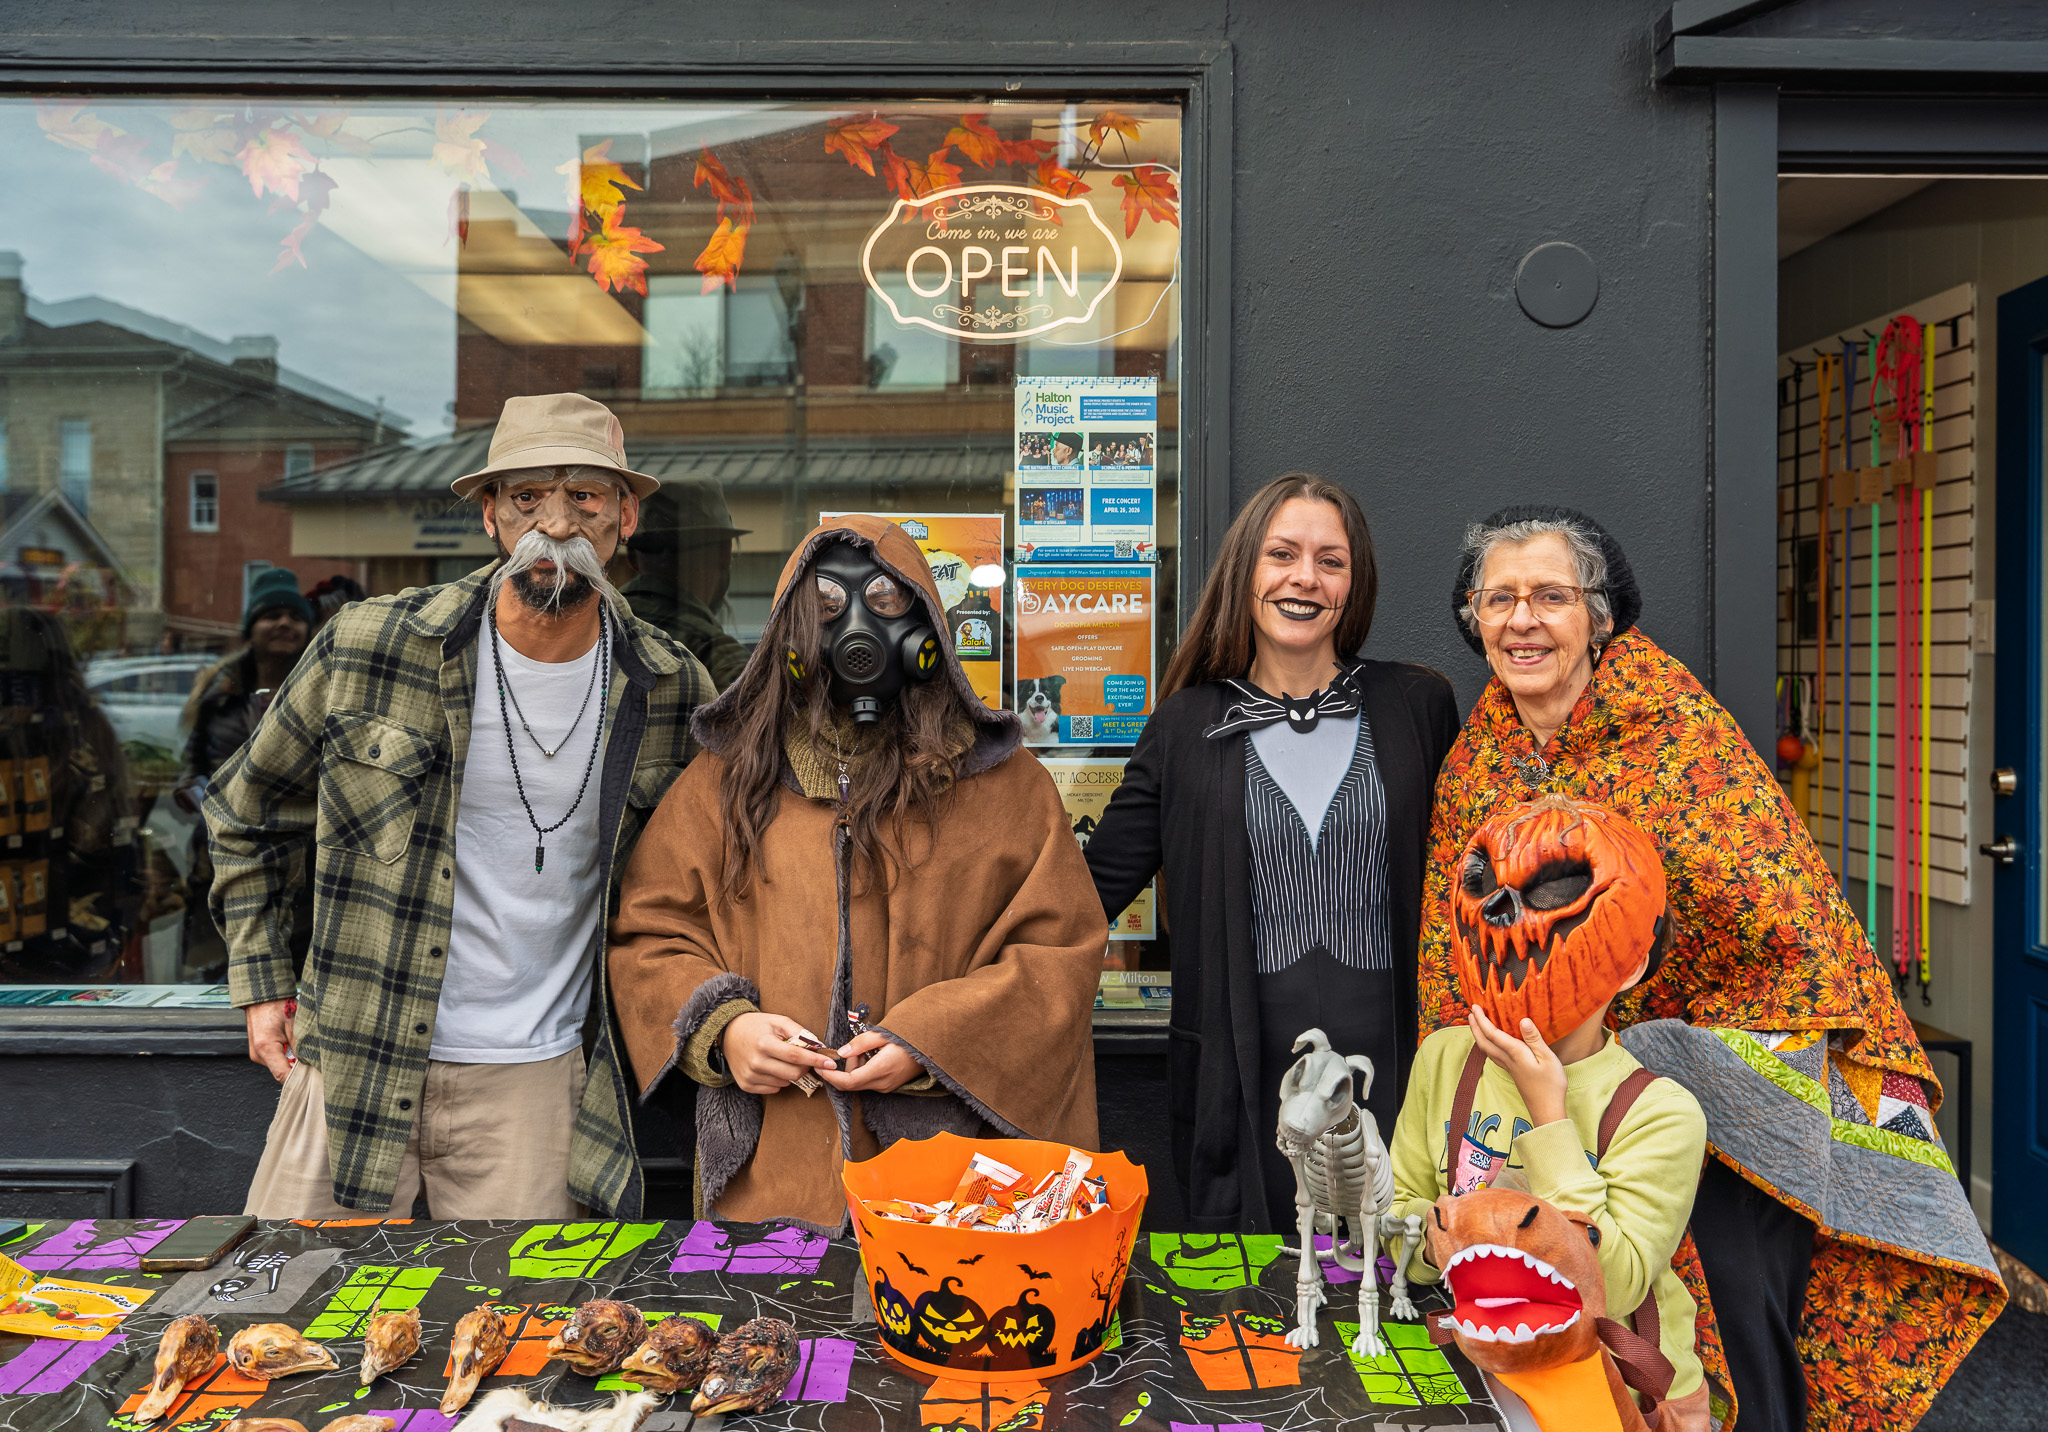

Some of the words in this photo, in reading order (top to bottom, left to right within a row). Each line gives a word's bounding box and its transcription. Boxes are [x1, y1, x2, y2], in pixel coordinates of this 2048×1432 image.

[927, 220, 971, 240] Come
[978, 226, 1001, 241] in,
[1005, 230, 1027, 240] we
[1032, 229, 1059, 240] are
[906, 246, 1079, 298] OPEN
[1036, 392, 1072, 402] Halton
[1036, 404, 1068, 414] Music
[1036, 415, 1074, 426] Project
[1024, 582, 1057, 590] EVERY
[1061, 582, 1084, 590] DOG
[1088, 582, 1142, 590] DESERVES
[1021, 593, 1143, 614] DAYCARE
[1053, 772, 1065, 784] AT
[1070, 772, 1123, 784] ACCESSI
[1120, 973, 1157, 983] Milton
[1472, 1151, 1492, 1164] JOLLY
[1051, 1162, 1075, 1219] WHOPPERS
